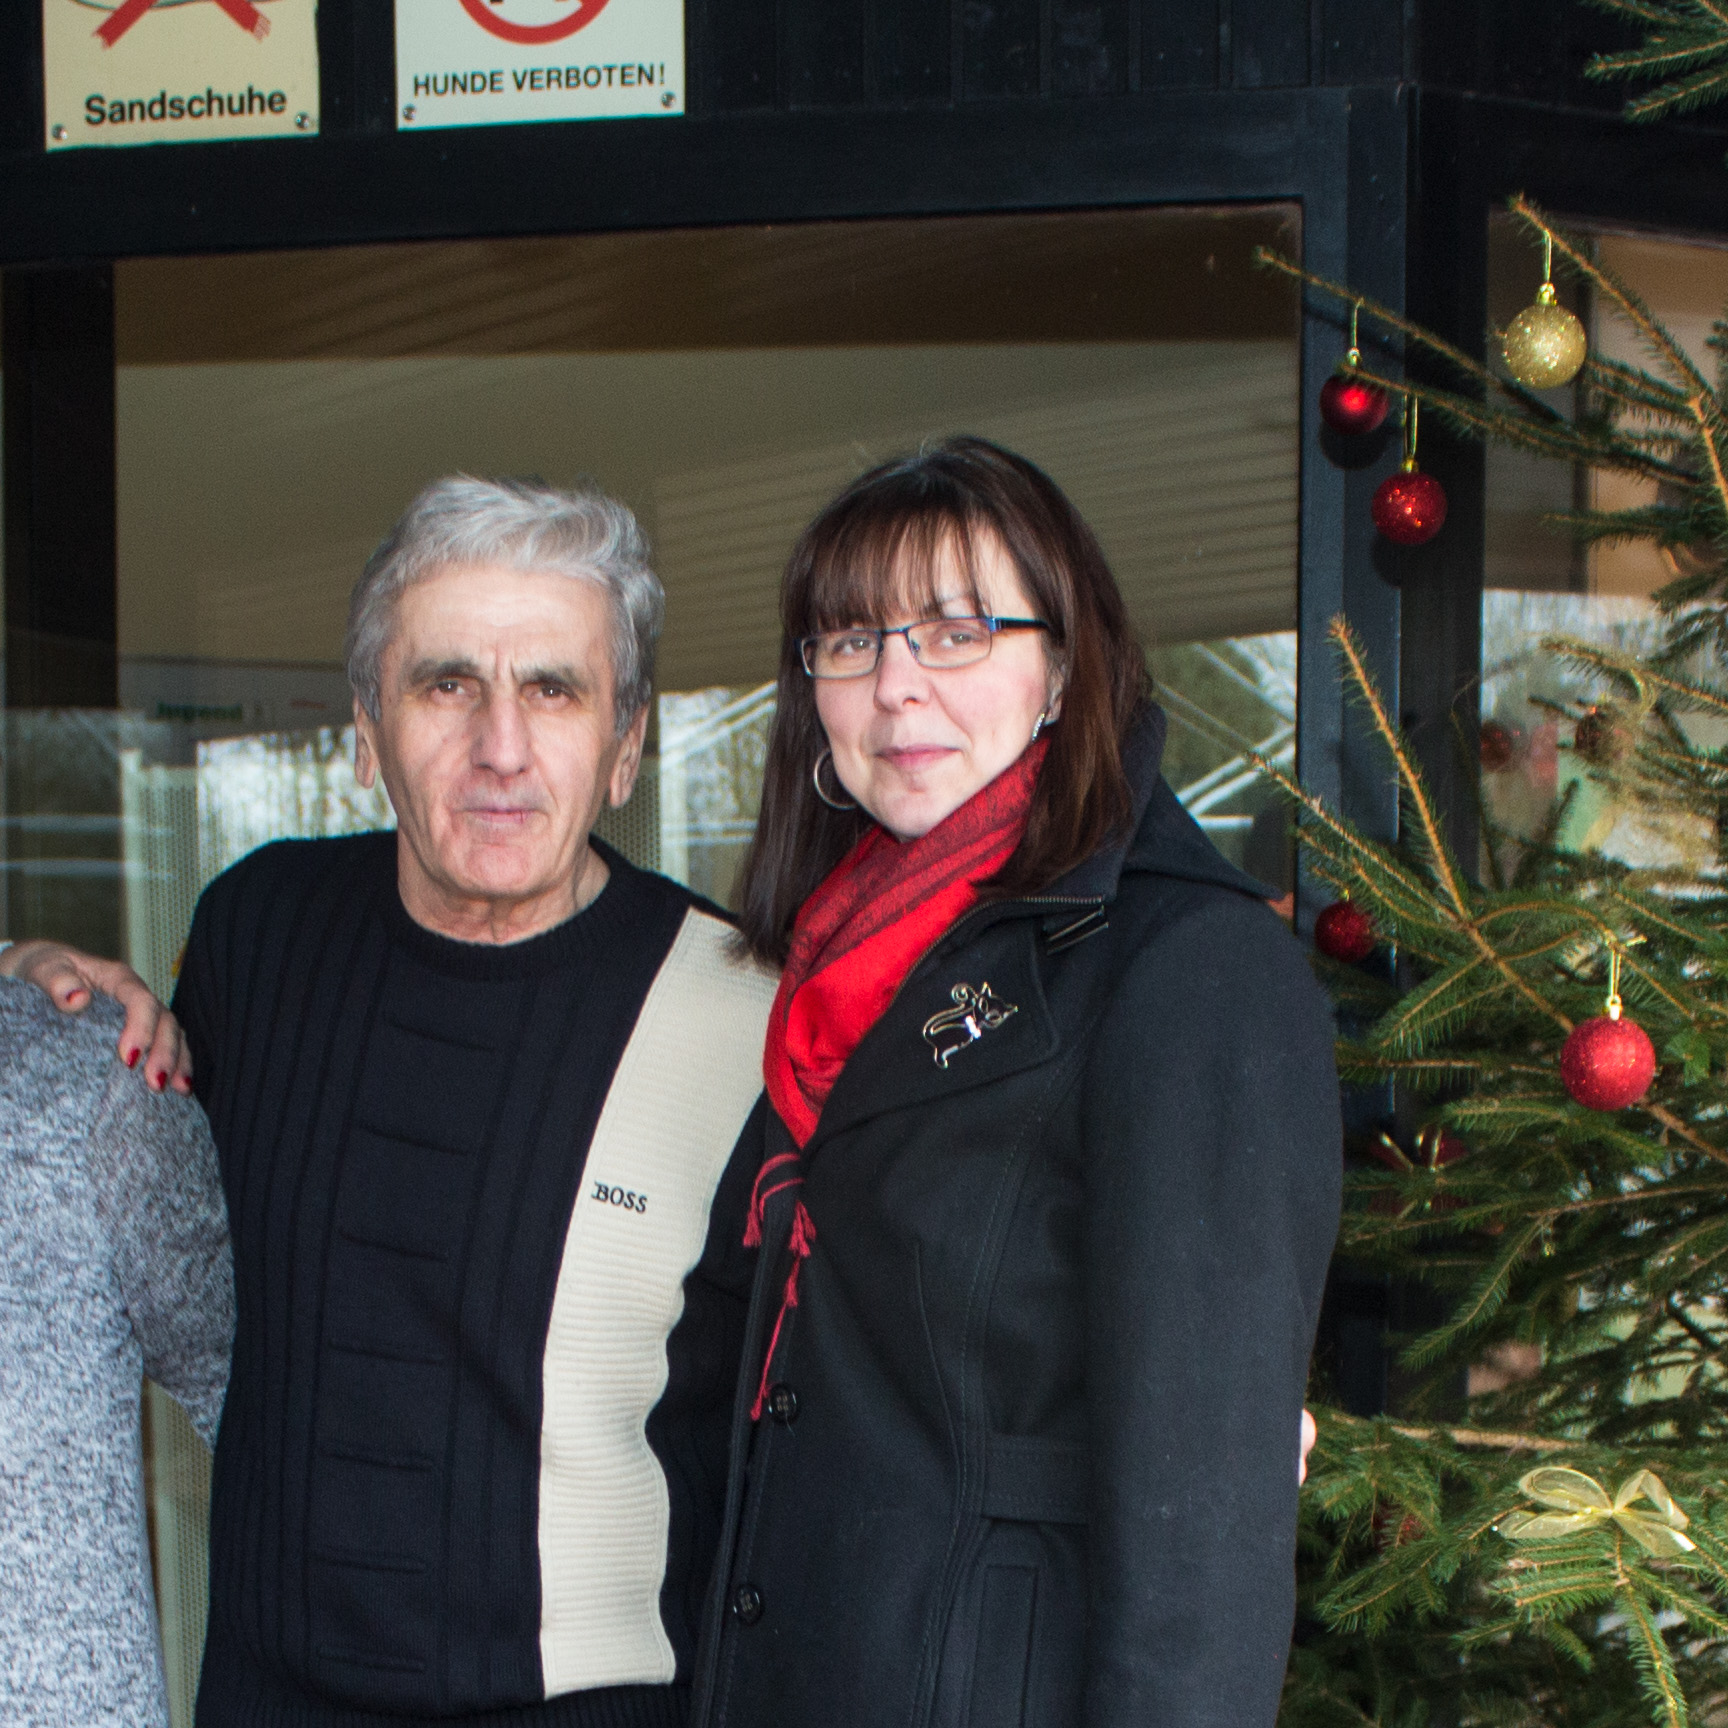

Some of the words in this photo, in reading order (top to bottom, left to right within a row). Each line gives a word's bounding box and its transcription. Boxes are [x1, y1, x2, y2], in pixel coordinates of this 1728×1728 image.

[413, 69, 504, 97] HUNDE
[512, 62, 665, 92] VERBOTEN!
[84, 83, 287, 126] Sandschuhe
[591, 1181, 648, 1214] BOSS
